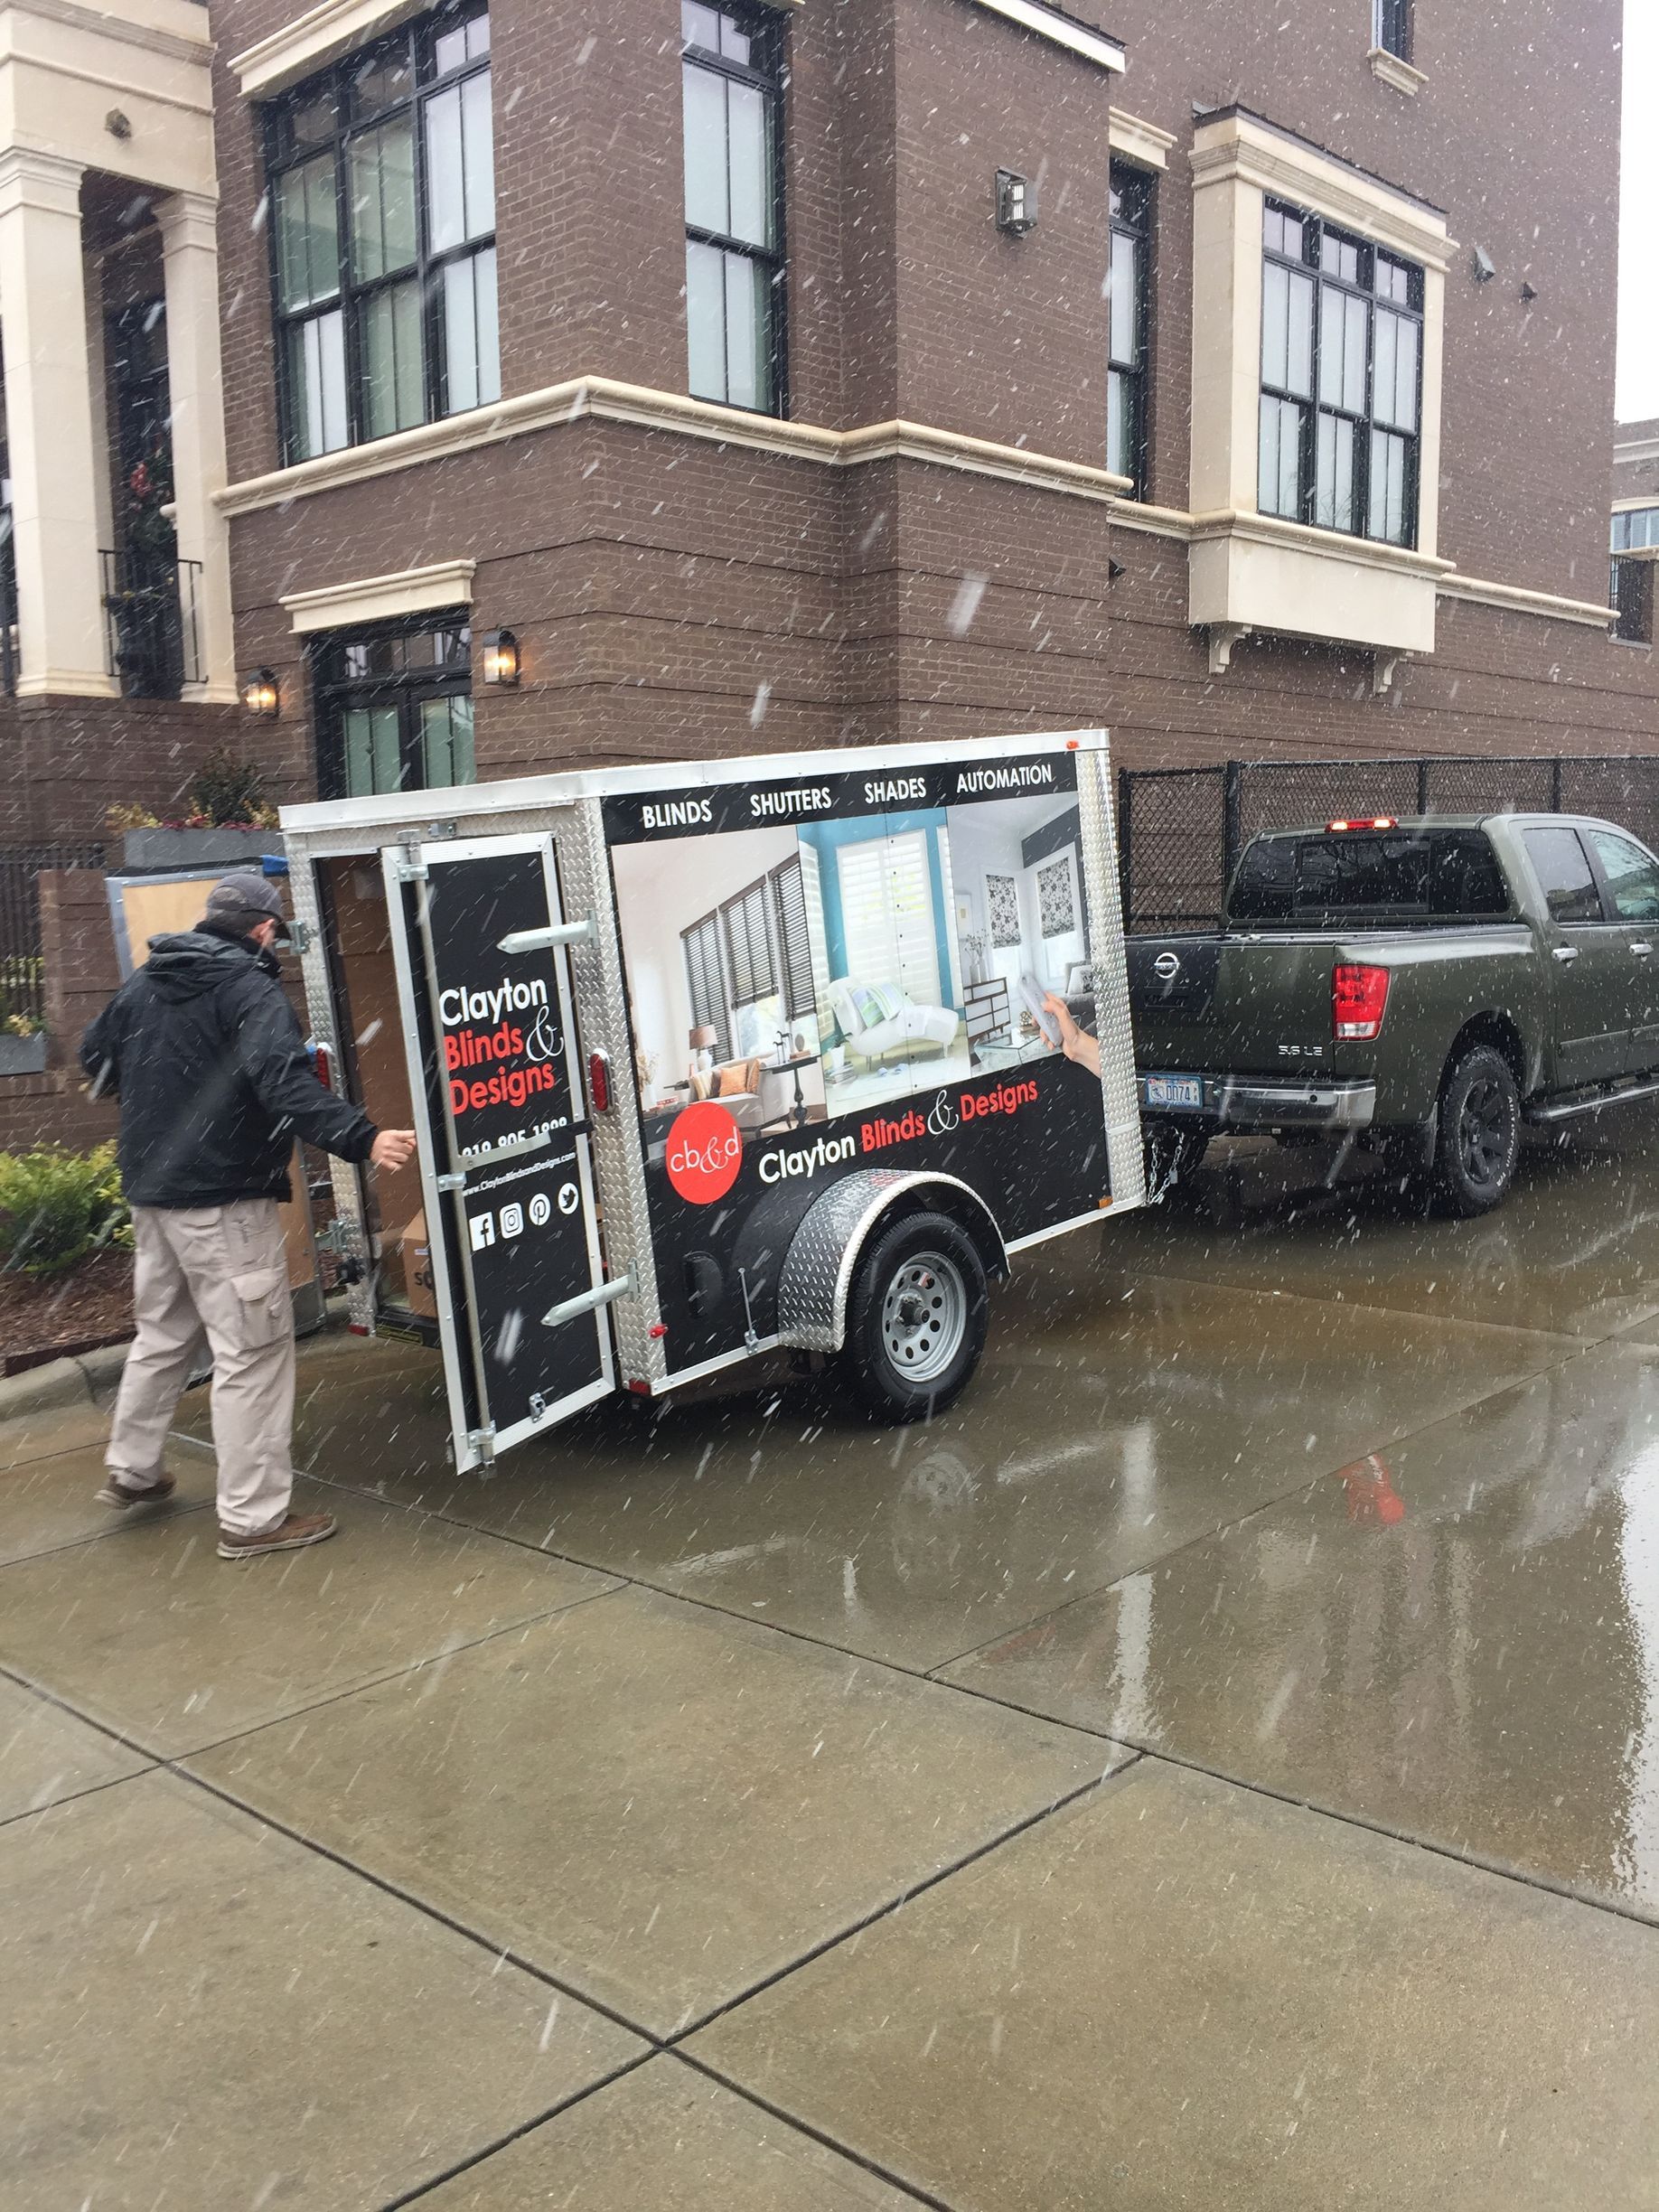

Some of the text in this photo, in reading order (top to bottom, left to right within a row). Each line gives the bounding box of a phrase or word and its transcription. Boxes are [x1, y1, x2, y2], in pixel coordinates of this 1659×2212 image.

[642, 764, 1053, 829] BLINDS SHUTTERS SHADES AUTOMATION
[439, 977, 548, 1026] Clayton
[444, 1005, 565, 1071] Blinds &
[448, 1063, 555, 1115] Designs
[670, 1126, 740, 1174] cb&d
[758, 1080, 1038, 1184] Clayton Blinds & Designs
